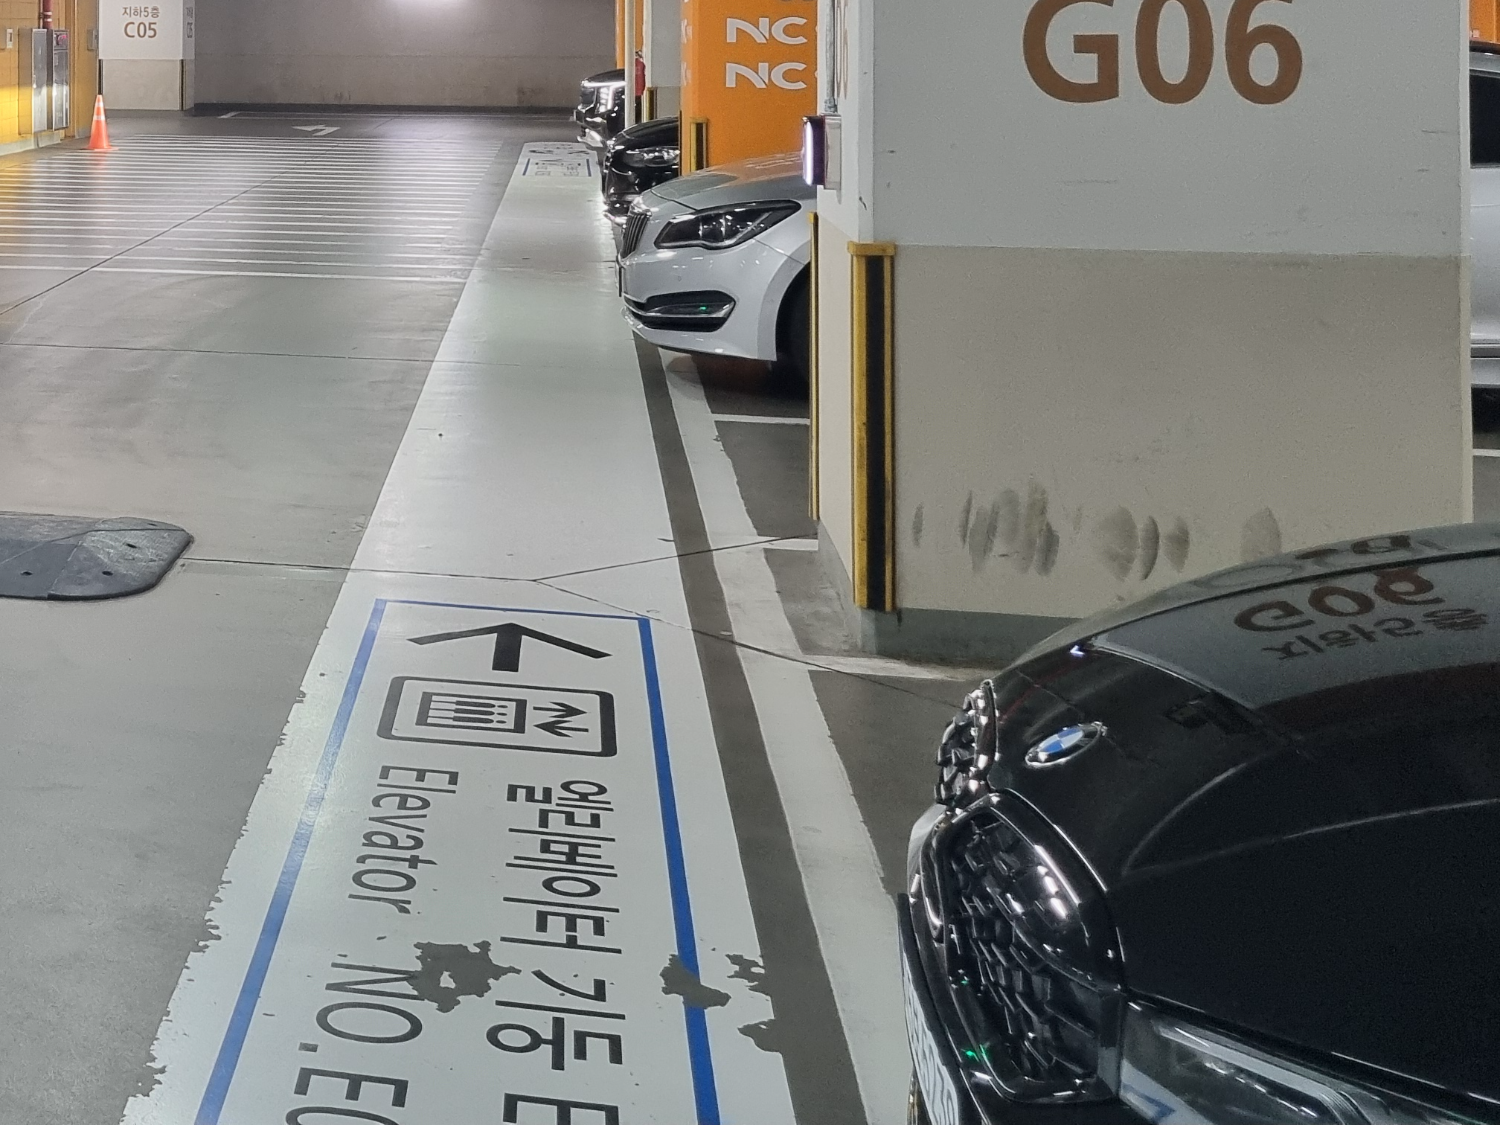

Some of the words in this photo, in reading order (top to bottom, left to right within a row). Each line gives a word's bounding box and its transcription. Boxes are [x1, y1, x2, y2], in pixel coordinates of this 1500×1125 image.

[122, 6, 160, 18] 지하5층
[123, 22, 158, 38] C05
[348, 765, 459, 915] Elevator
[500, 780, 622, 954] 엘리베이터
[486, 968, 626, 1071] 기둥
